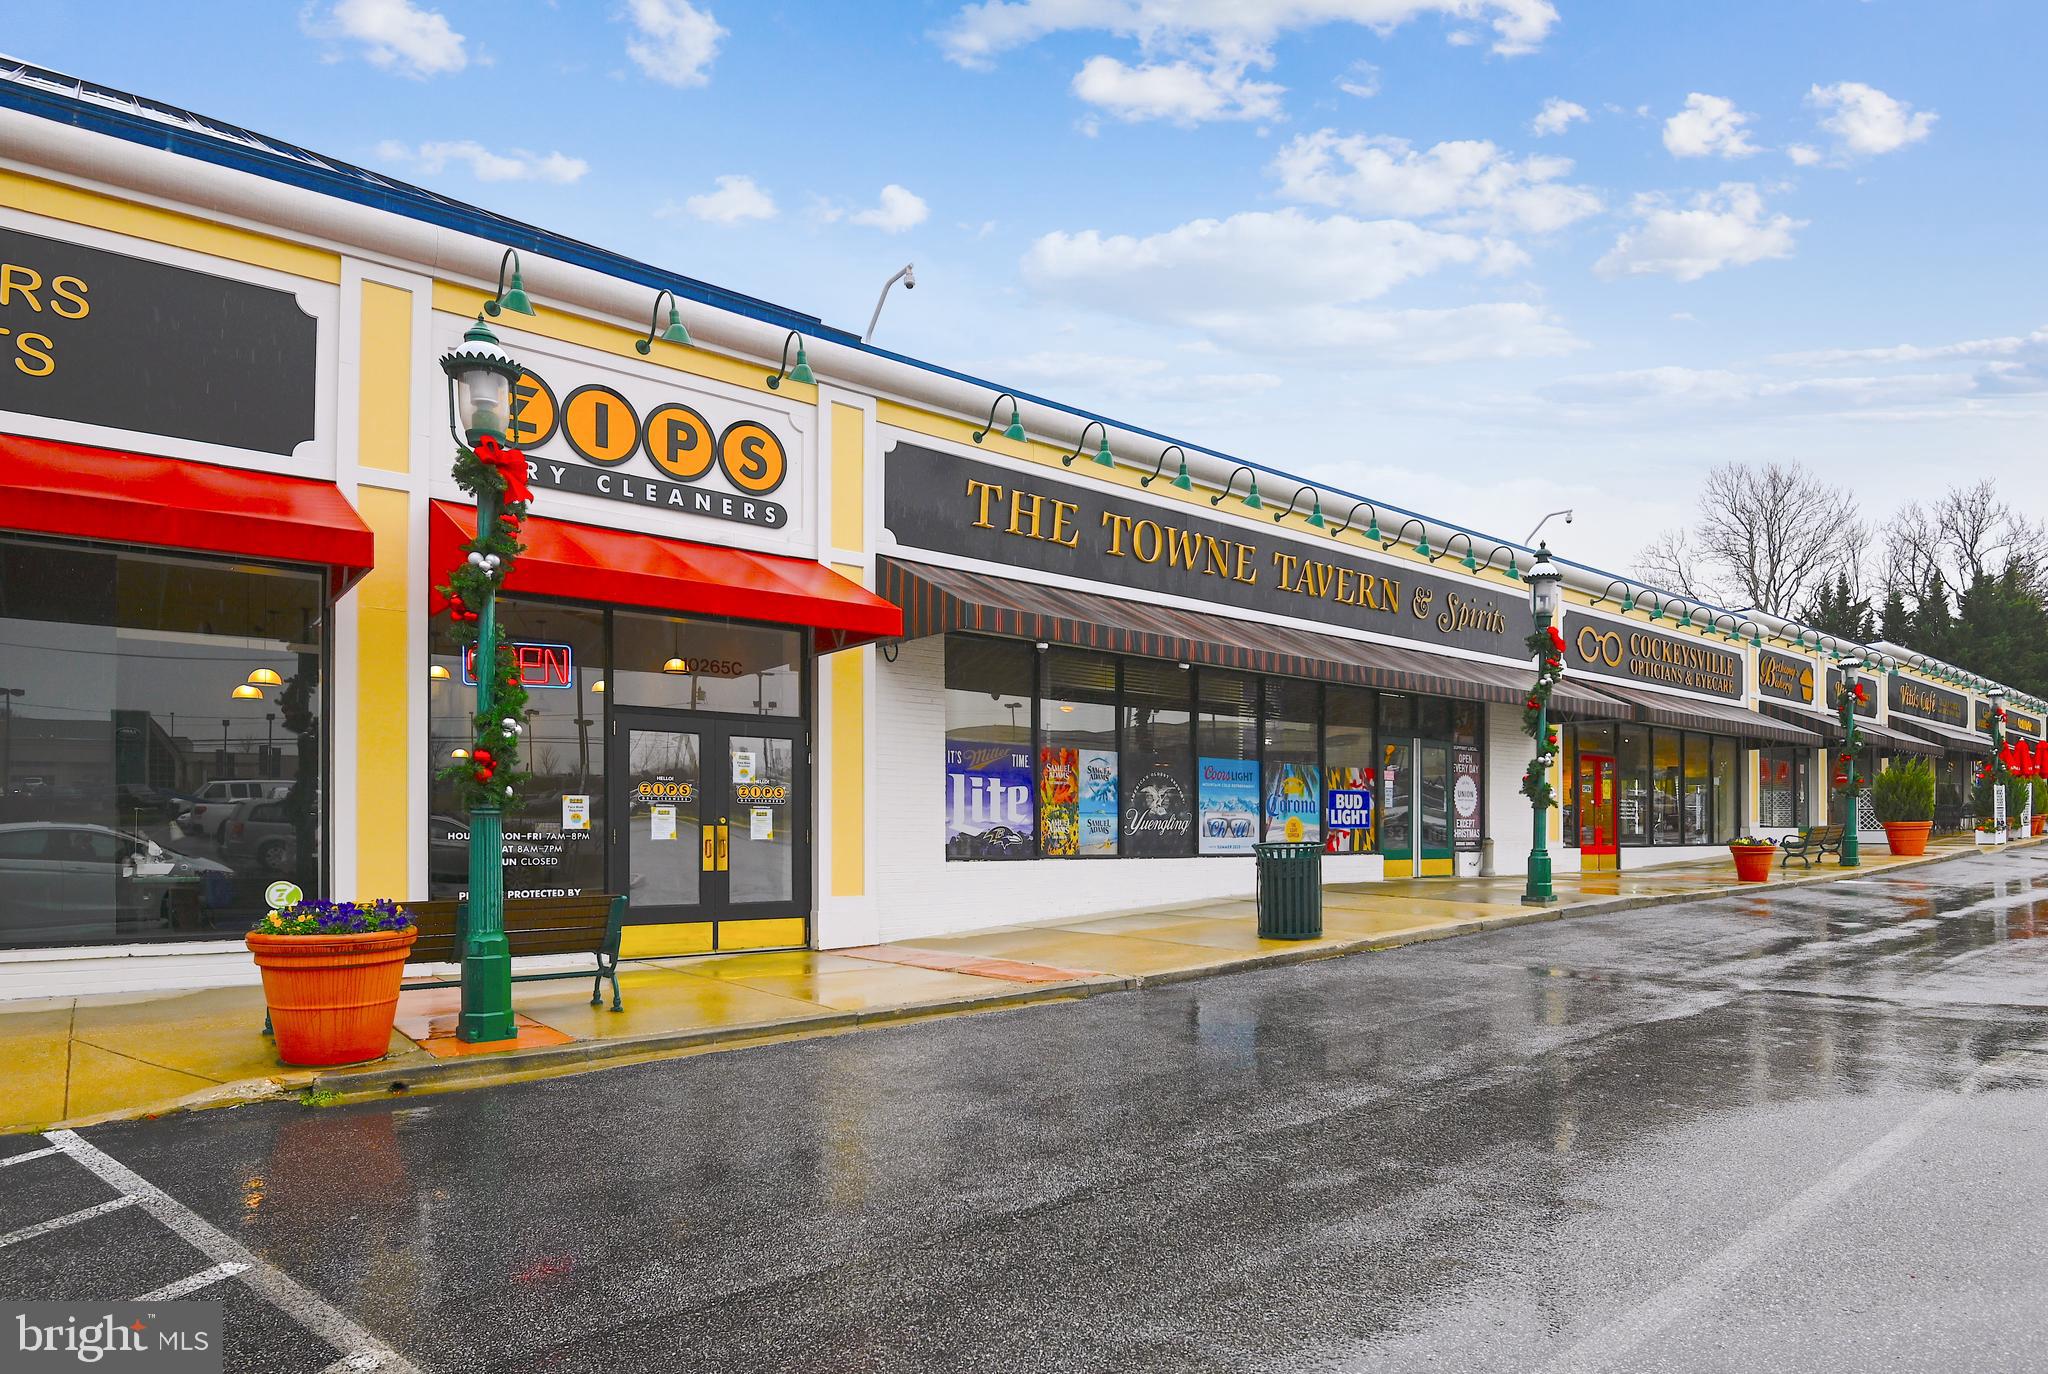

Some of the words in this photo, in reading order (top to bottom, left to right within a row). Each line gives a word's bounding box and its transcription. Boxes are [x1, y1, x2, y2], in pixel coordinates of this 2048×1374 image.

[526, 460, 566, 485] RY
[596, 474, 777, 524] CLEANERS
[966, 479, 1080, 549] THE
[1102, 511, 1257, 585] TOWNE
[1274, 551, 1399, 614] TAVERN
[1412, 586, 1433, 620] &
[1437, 592, 1505, 634] Spirits
[1630, 632, 1734, 678] COCKEYSVILLE
[683, 658, 743, 676] 10265C
[1630, 658, 1683, 685] OPTICIANS
[1685, 671, 1693, 686] &
[1695, 673, 1734, 694] EYECARE
[947, 750, 962, 764] IT'S
[964, 748, 1011, 768] Miller
[1458, 754, 1472, 763] OPEN
[1046, 763, 1072, 774] SAMUEL
[1087, 765, 1112, 776] SAMUEL
[1204, 765, 1231, 781] Coors
[1231, 771, 1253, 782] LIGHT
[1469, 764, 1479, 774] DAY
[1048, 771, 1070, 781] ADAMS
[1089, 773, 1110, 782] ADAMS
[640, 783, 690, 797] ZIPS
[739, 786, 784, 799] ZIPS
[1457, 790, 1474, 798] UNION
[948, 773, 1030, 837] Lite
[1267, 794, 1317, 819] Corona
[1336, 794, 1362, 809] BUD
[1087, 818, 1111, 828] SAMUEL
[1124, 808, 1192, 836] Yuengling
[1331, 809, 1368, 825] LIGHT
[1456, 819, 1475, 828] EXCEPT
[1089, 826, 1110, 835] ADAMS
[502, 845, 513, 853] AT
[502, 858, 517, 866] UN
[520, 857, 558, 865] CLOSED
[507, 889, 564, 899] PROTECTED
[567, 888, 581, 897] BY
